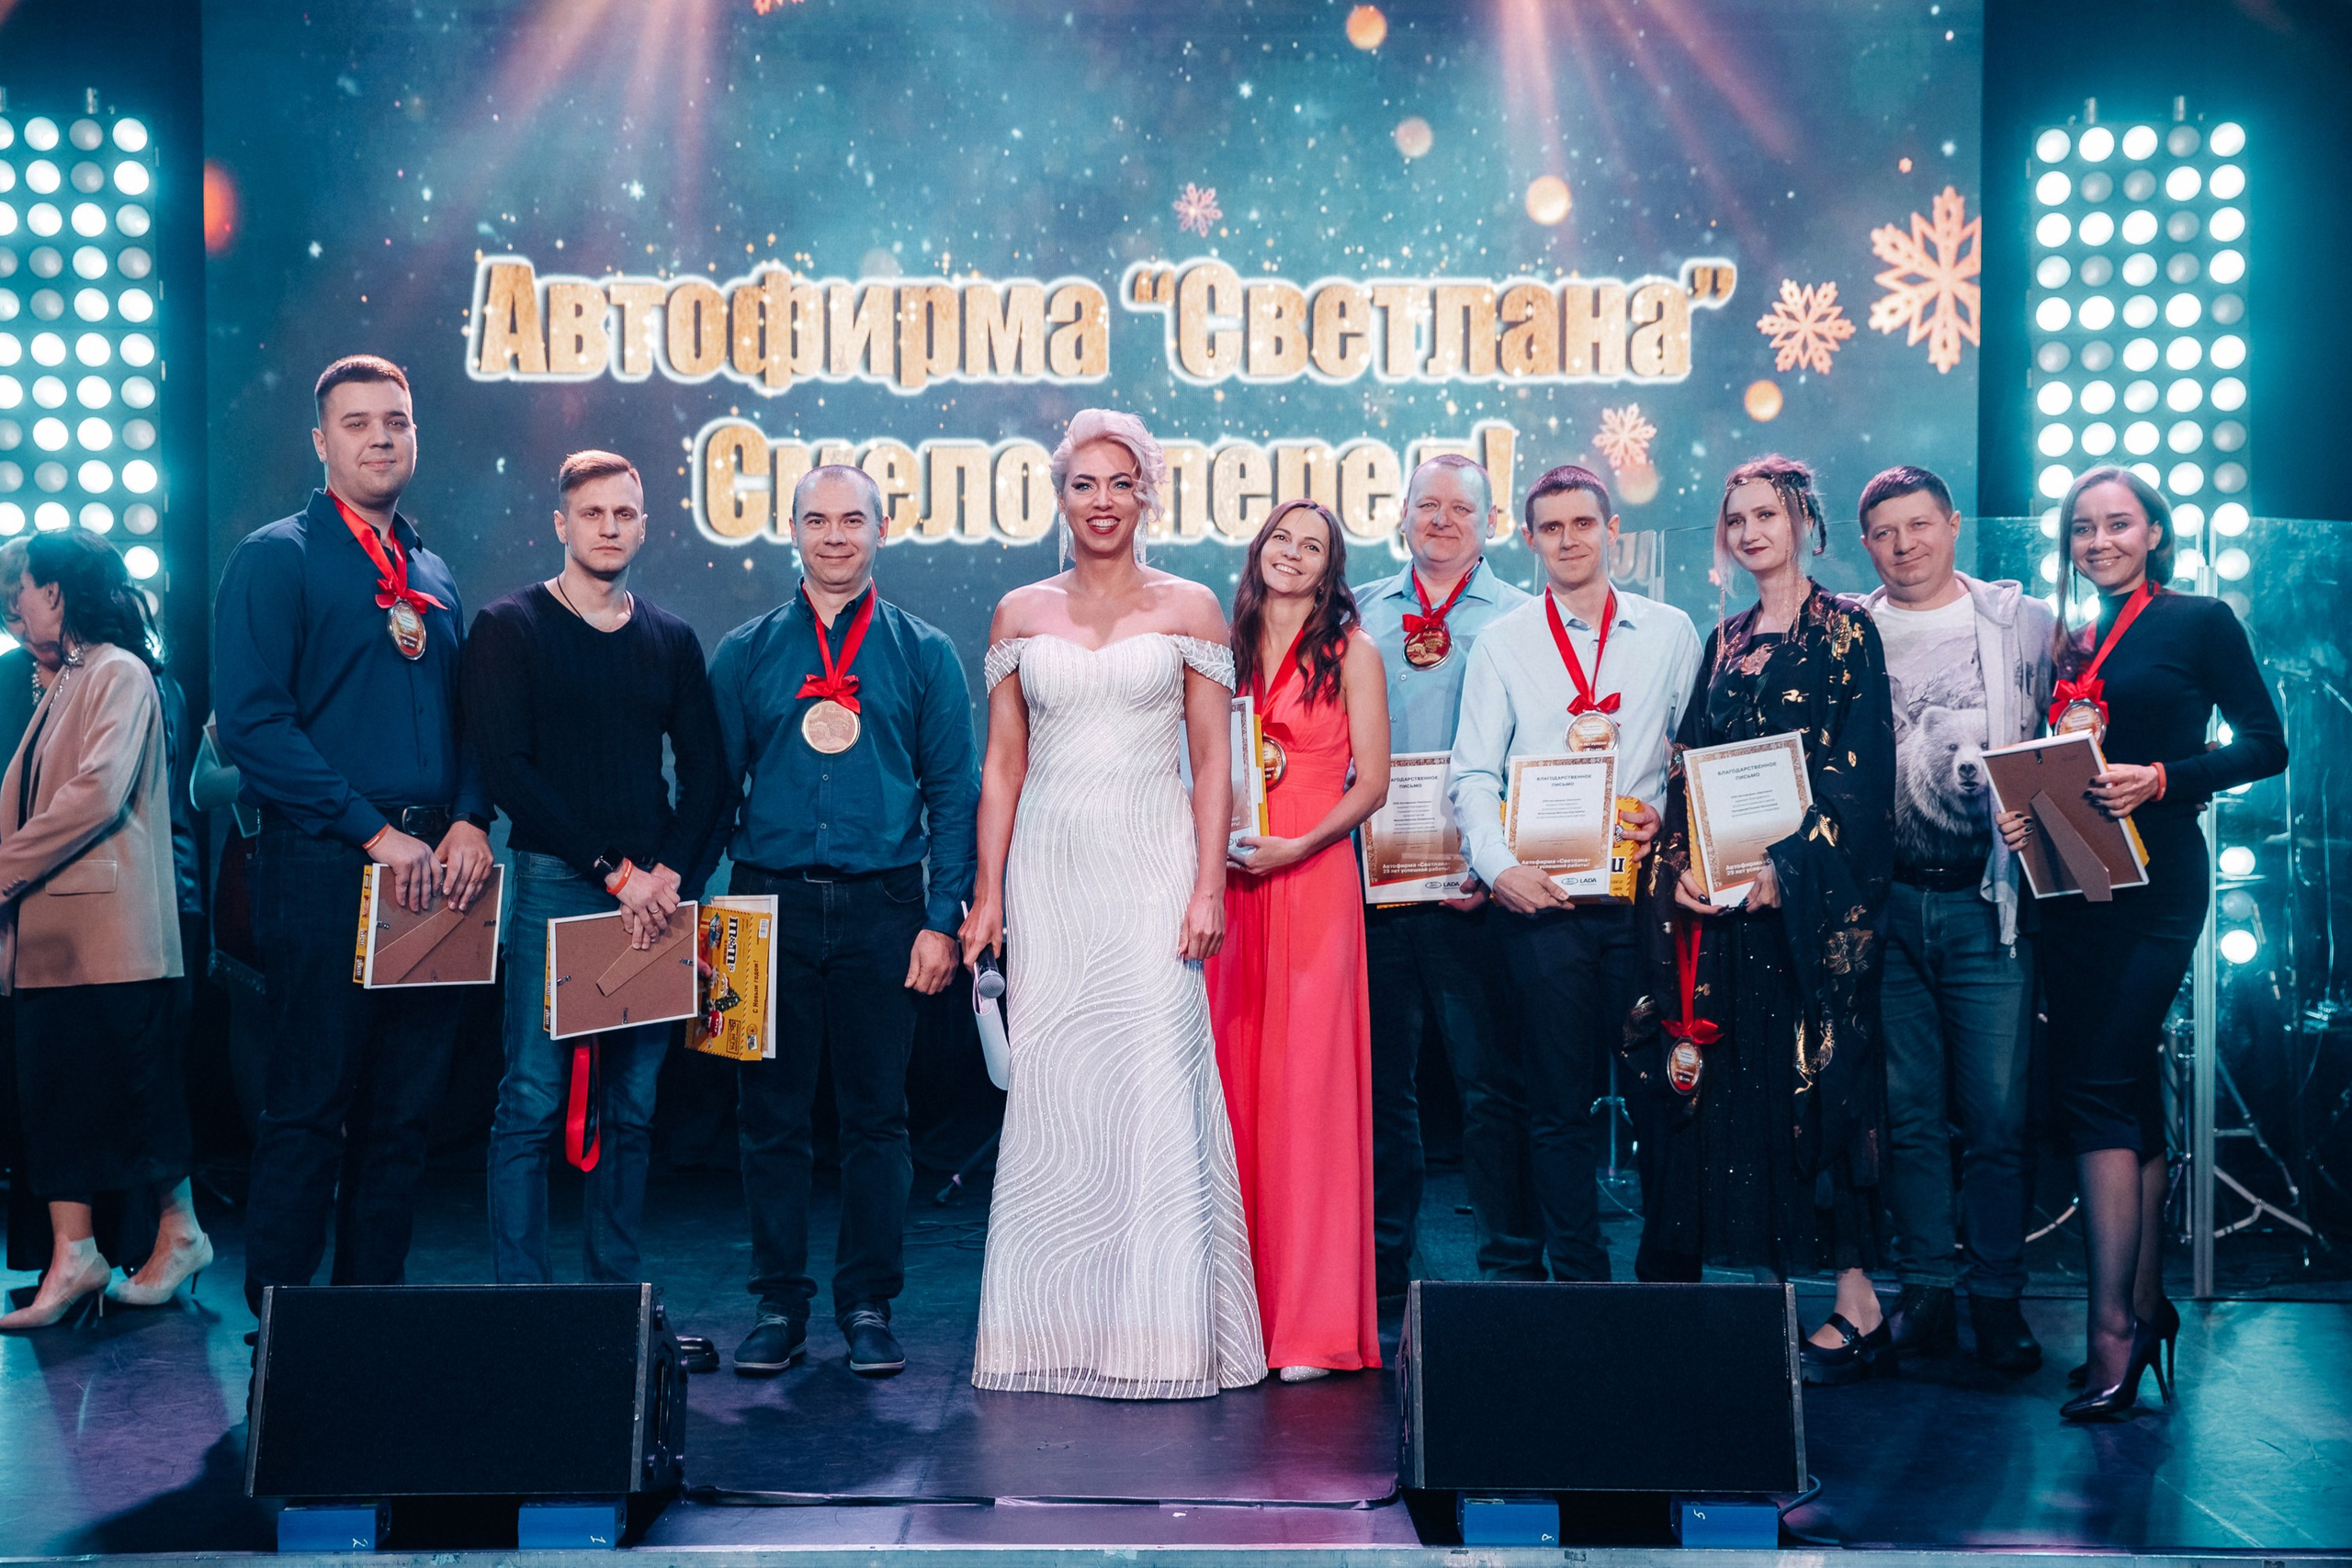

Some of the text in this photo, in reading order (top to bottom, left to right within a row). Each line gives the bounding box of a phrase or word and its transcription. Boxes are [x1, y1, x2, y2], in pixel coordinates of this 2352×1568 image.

[478, 263, 1108, 387] Автофирма
[1718, 761, 1777, 776] БЛАГОДАРСТВЕННОЕ
[1736, 773, 1760, 781] ПИСЬМО
